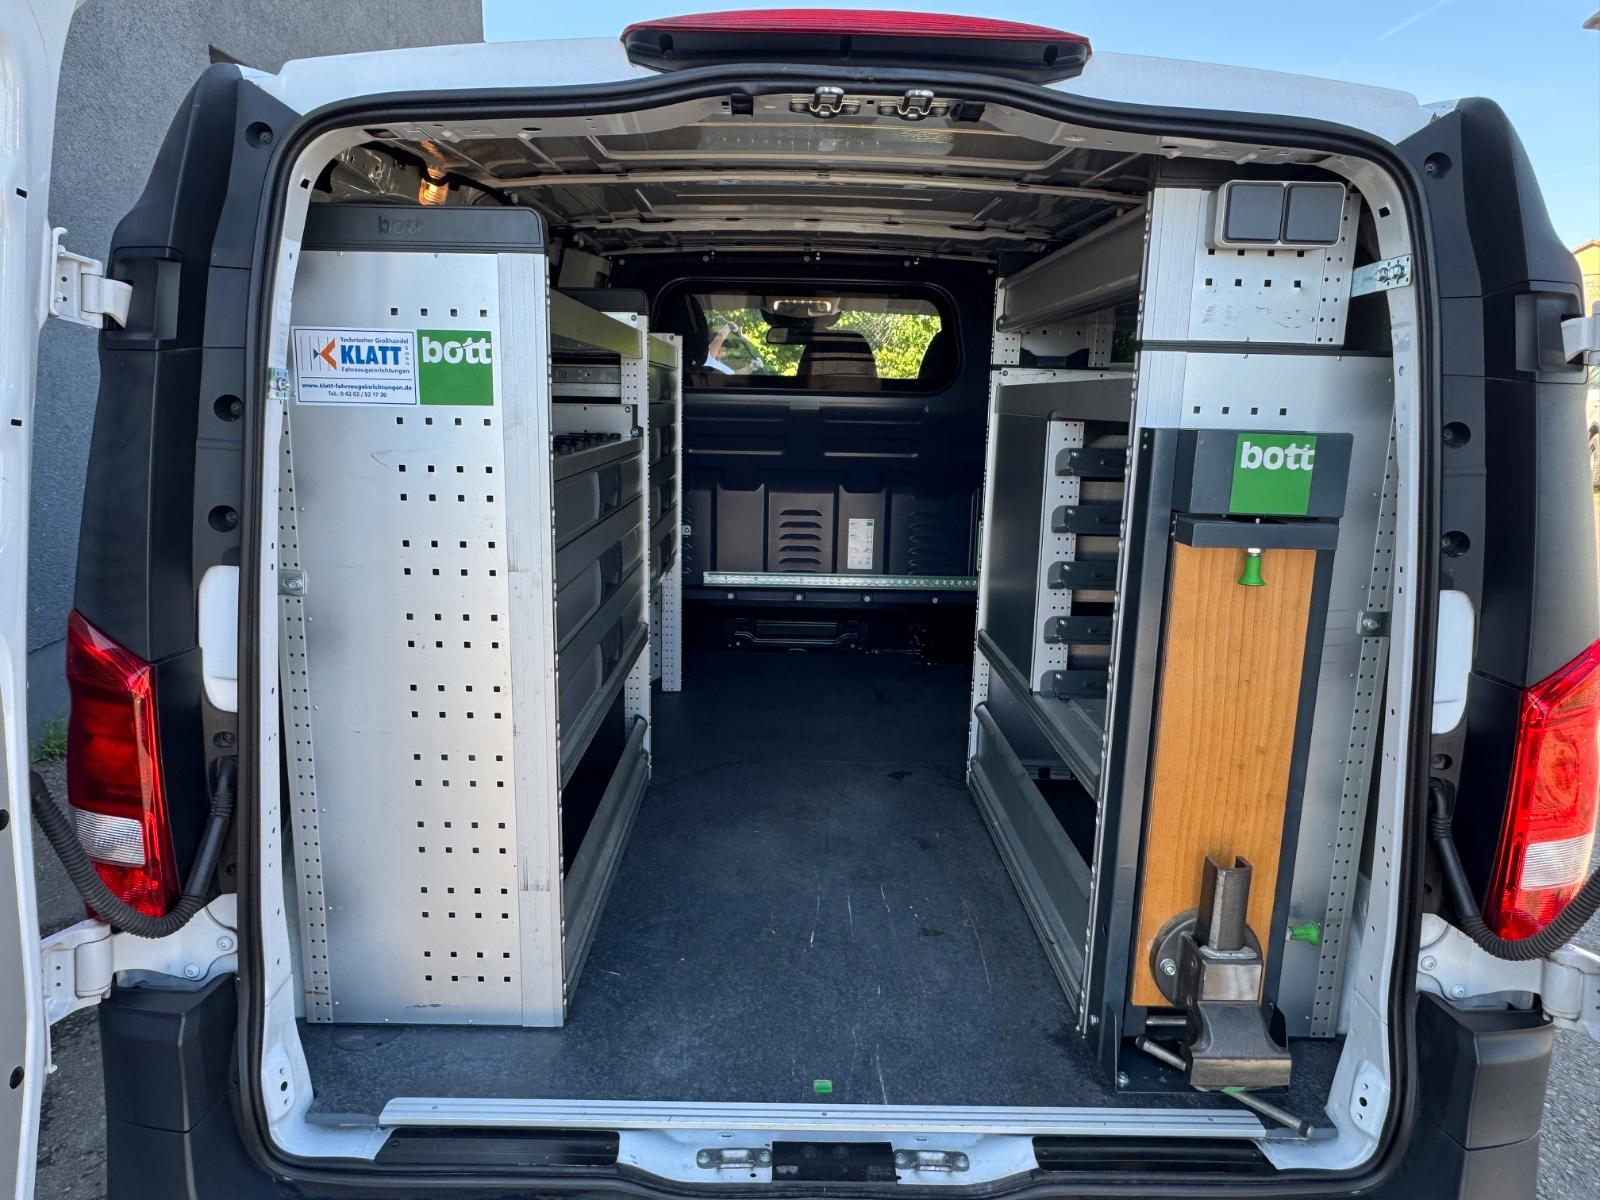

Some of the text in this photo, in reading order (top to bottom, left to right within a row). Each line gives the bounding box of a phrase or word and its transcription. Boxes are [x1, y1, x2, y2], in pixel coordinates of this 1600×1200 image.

[340, 345, 402, 365] KLATT
[421, 336, 492, 364] bott
[341, 367, 410, 375] Fahrzeugeinrichtungen
[301, 383, 412, 391] www.klatt-fahrzeugeinrichtungen.de
[1240, 441, 1315, 470] bott
